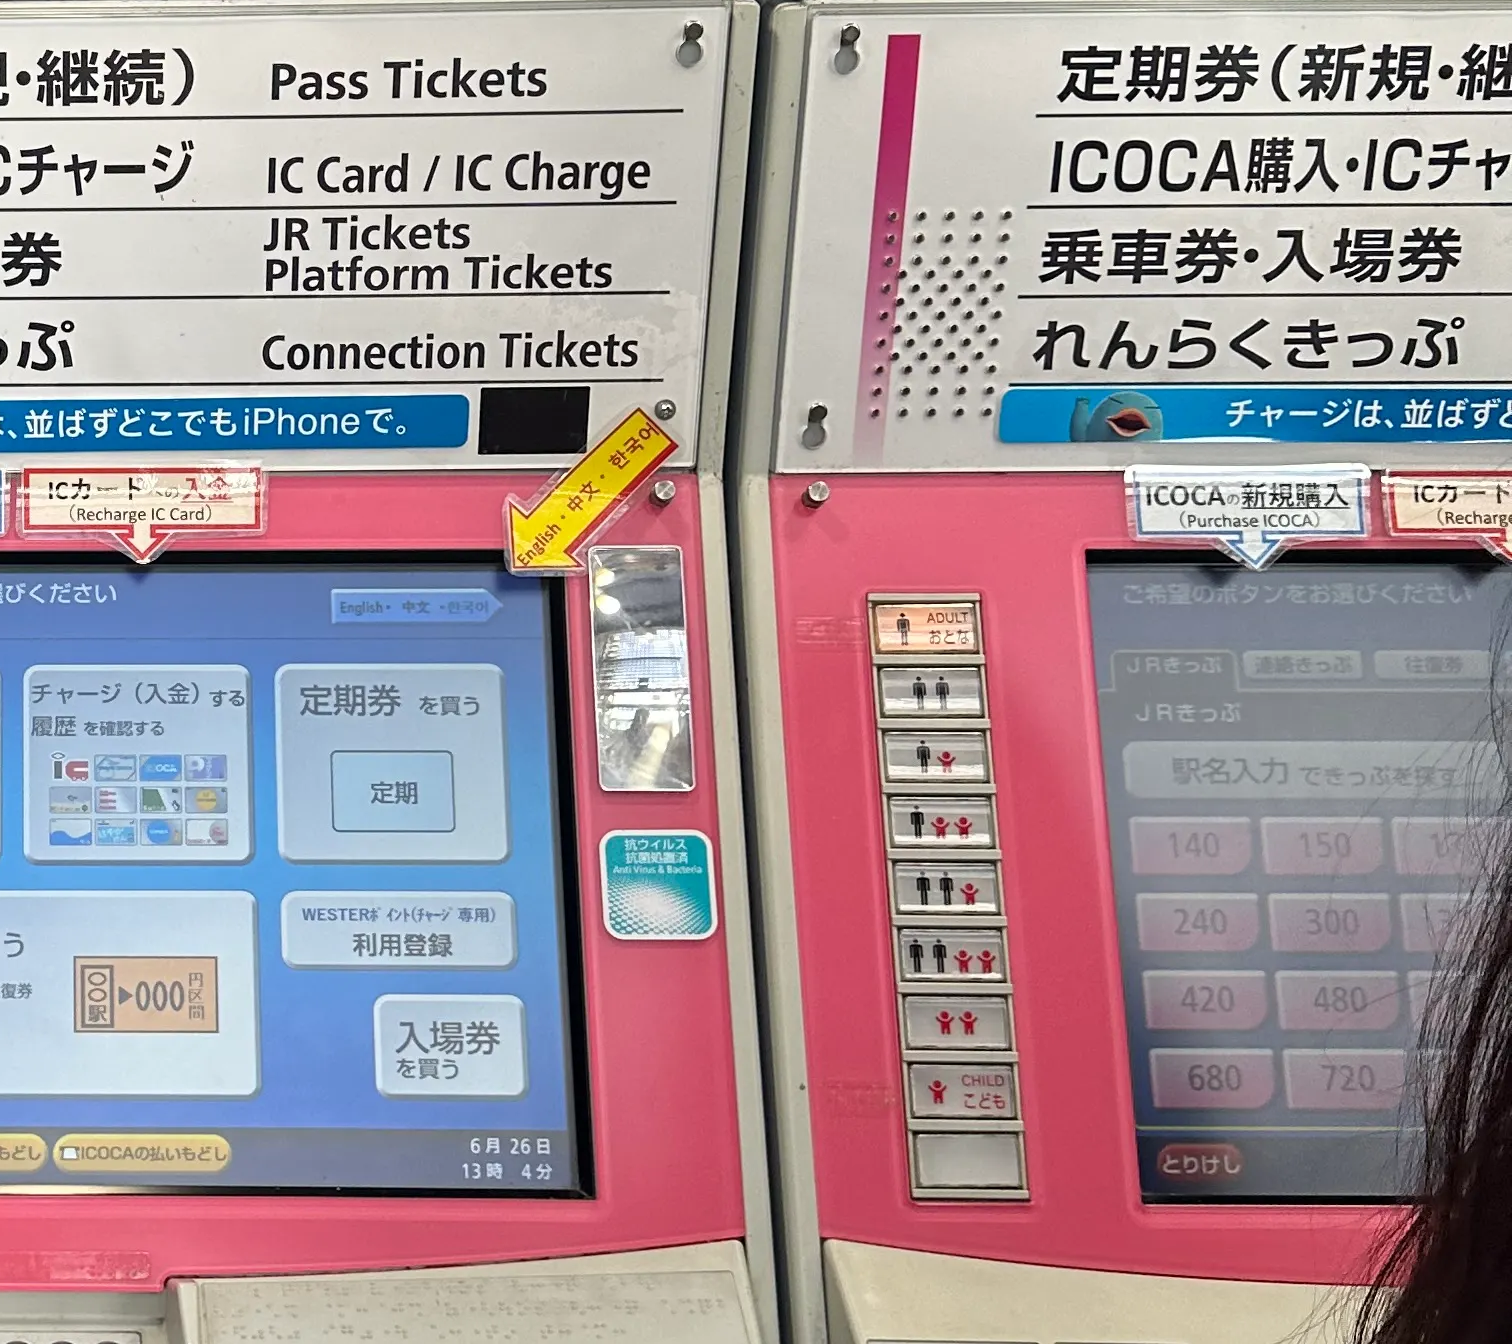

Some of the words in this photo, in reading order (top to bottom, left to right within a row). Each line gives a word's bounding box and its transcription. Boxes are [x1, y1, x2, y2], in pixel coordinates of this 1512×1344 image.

[270, 63, 369, 101] Pass
[383, 58, 548, 99] Tickets
[267, 156, 304, 194] IC
[316, 152, 410, 194] Card
[454, 154, 492, 192] IC
[504, 151, 652, 200] Charge
[263, 216, 310, 253] JR
[322, 214, 471, 251] Tickets
[1039, 226, 1464, 286] 乗車券・入場券
[264, 255, 450, 292] Platform
[463, 253, 614, 290] Tickets
[261, 333, 486, 371] Connection
[499, 330, 639, 369] Tickets
[1033, 316, 1465, 371] れんらくきっぷ
[1145, 482, 1350, 507] ICOCAの新規購入
[150, 506, 167, 521] IC
[1122, 582, 1473, 605] ご希望のボタンをお選びください
[926, 611, 969, 624] ADULT
[928, 629, 970, 645] おとな
[299, 684, 402, 717] 定期券
[418, 695, 481, 717] を買う
[1172, 757, 1288, 785] 駅名入力
[370, 781, 419, 806] 定期
[1167, 832, 1220, 858] 140
[1298, 832, 1352, 858] 150
[1174, 908, 1227, 935] 240
[1305, 908, 1360, 935] 300
[352, 932, 453, 958] 利用登録
[1180, 986, 1235, 1013] 420
[1313, 986, 1368, 1013] 480
[395, 1020, 501, 1056] 入場券
[395, 1057, 459, 1080] を買う
[961, 1074, 1005, 1087] CHILD
[1188, 1064, 1242, 1091] 680
[1320, 1064, 1375, 1091] 720
[963, 1092, 1006, 1109] こども
[1161, 1154, 1241, 1173] とりけし
